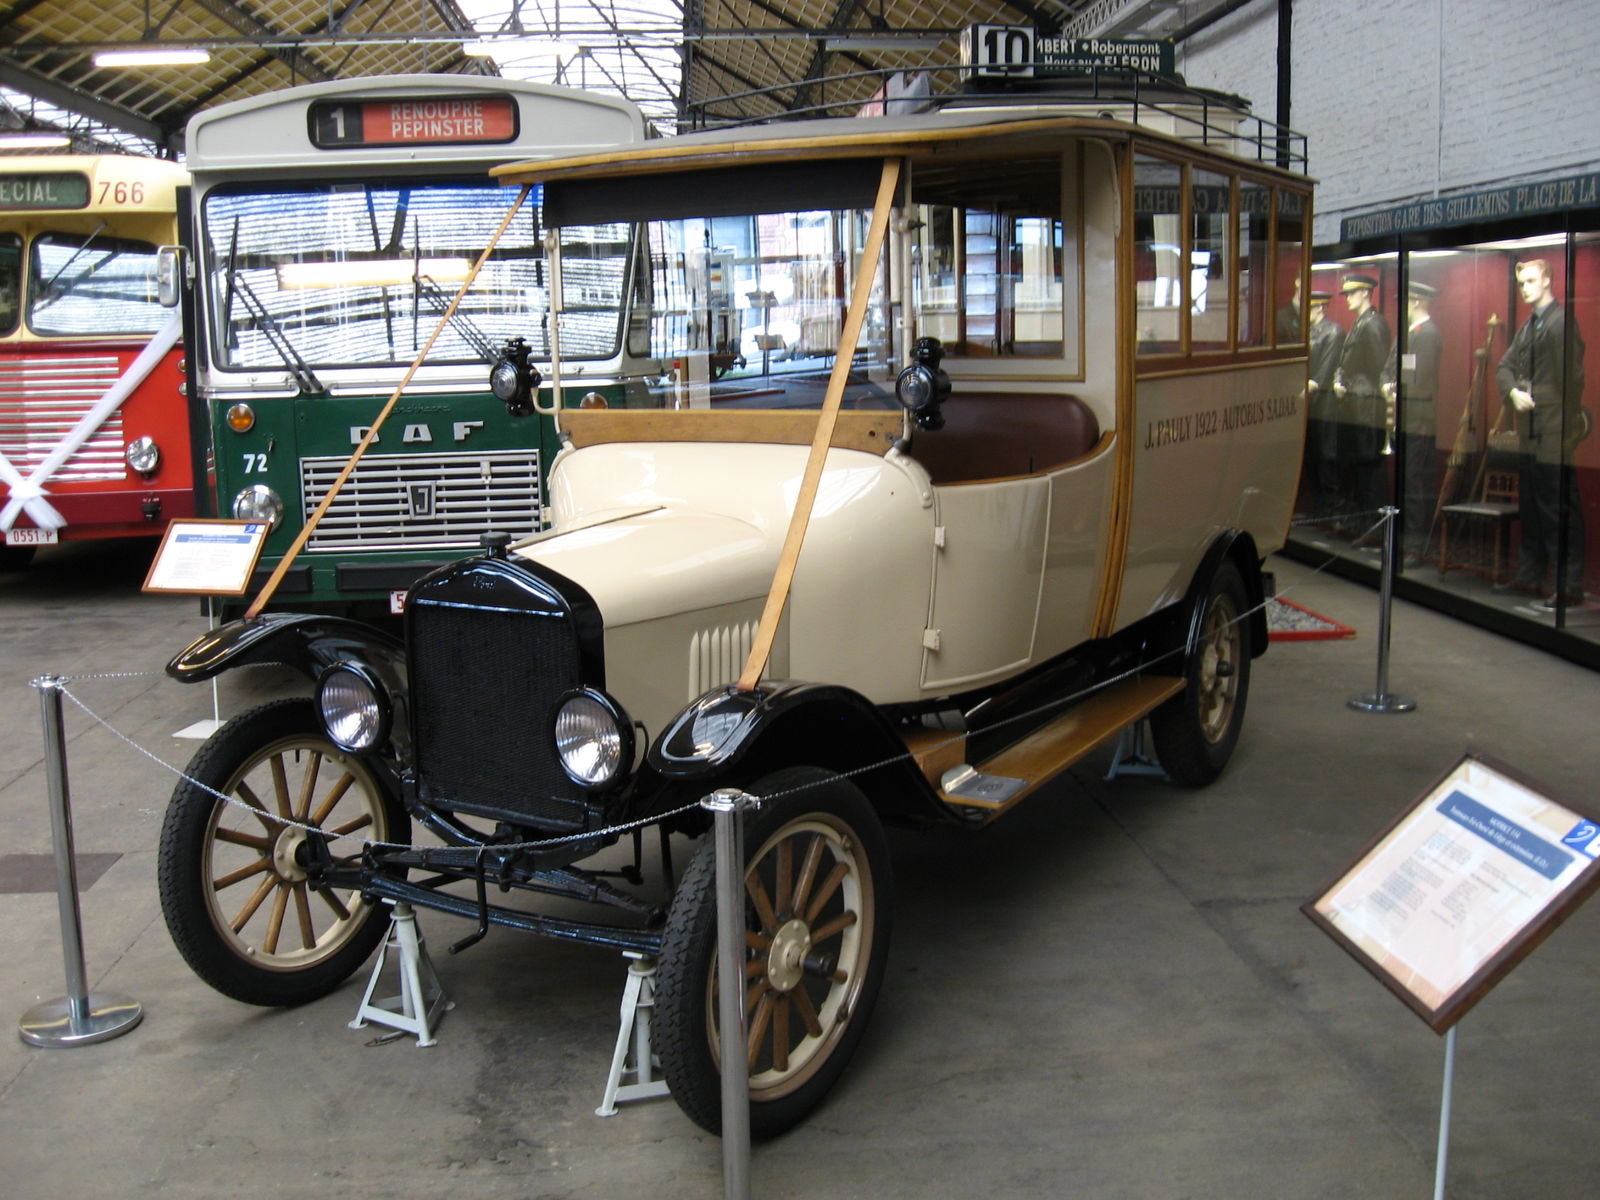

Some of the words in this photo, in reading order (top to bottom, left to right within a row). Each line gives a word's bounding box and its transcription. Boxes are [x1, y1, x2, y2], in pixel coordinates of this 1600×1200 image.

[984, 29, 1030, 73] 10
[1091, 39, 1161, 55] Robermont
[330, 107, 346, 138] 1
[391, 101, 483, 121] RENOUPRE
[392, 119, 484, 139] PEPINSTER
[98, 181, 144, 205] 766
[1347, 213, 1393, 239] EXPOSITION
[1394, 206, 1420, 230] GARE
[1422, 202, 1443, 226] DES
[1446, 190, 1510, 222] GUILLEMINS
[1515, 182, 1557, 212] PLACE
[1558, 178, 1576, 205] DE
[1578, 175, 1598, 204] LA
[350, 420, 484, 445] DAF
[1157, 414, 1192, 448] PAULY
[1194, 409, 1218, 439] 1922
[1221, 400, 1265, 432] AUTOBUS
[243, 453, 268, 474] 72
